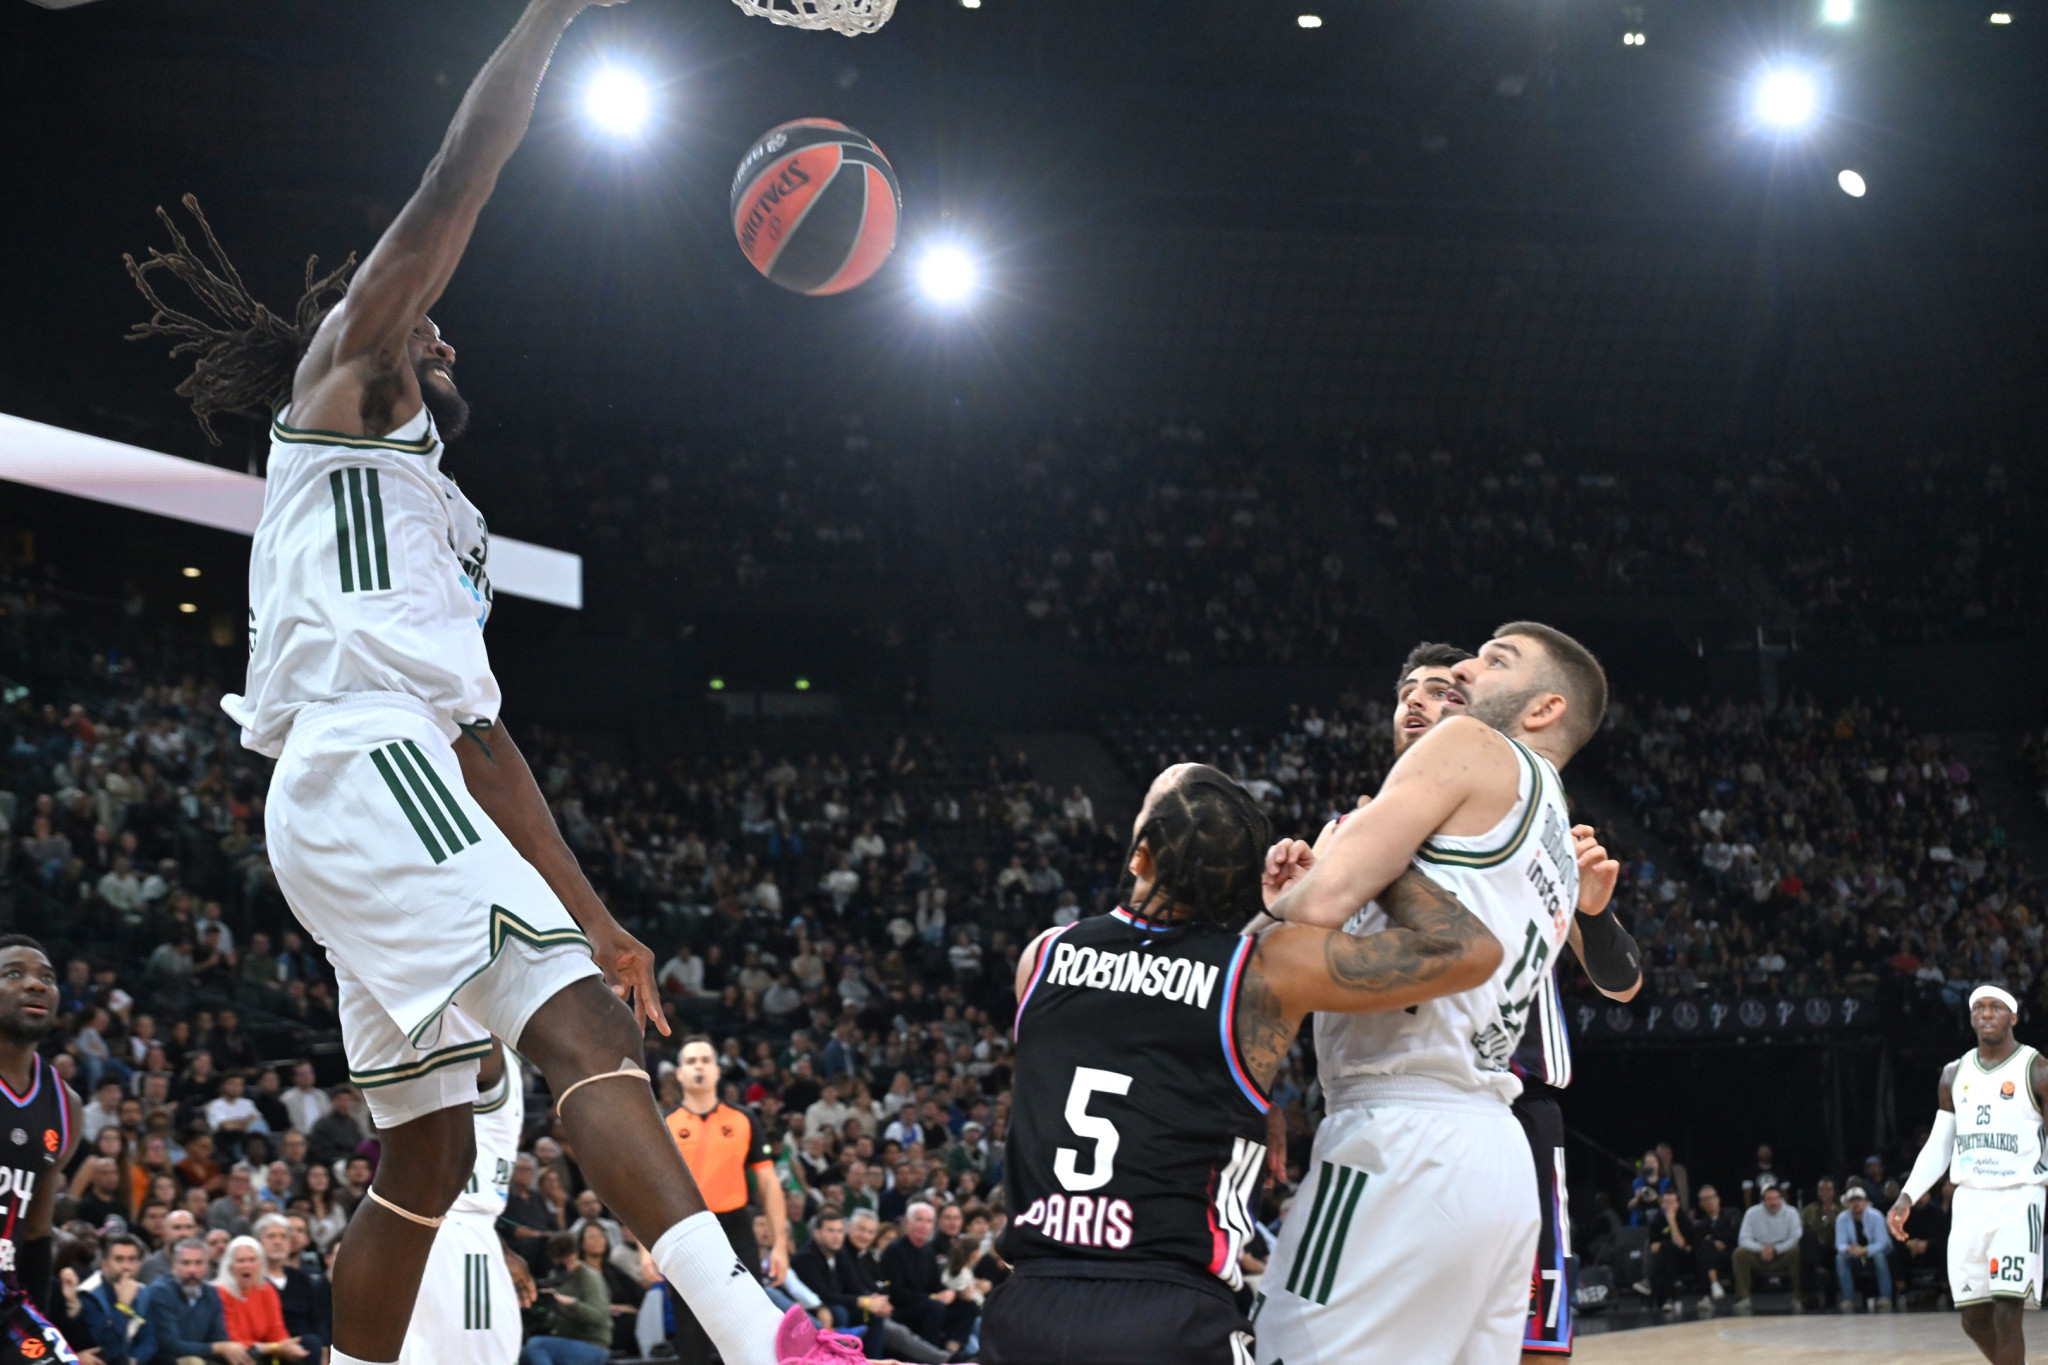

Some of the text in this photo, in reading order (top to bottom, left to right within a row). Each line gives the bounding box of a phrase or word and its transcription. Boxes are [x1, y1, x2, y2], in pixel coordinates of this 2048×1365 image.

[1047, 942, 1219, 1009] ROBINSON
[1053, 1066, 1133, 1191] 5
[1976, 1104, 1992, 1126] 25
[1014, 1193, 1133, 1249] PARIS
[2001, 1255, 2025, 1282] 25
